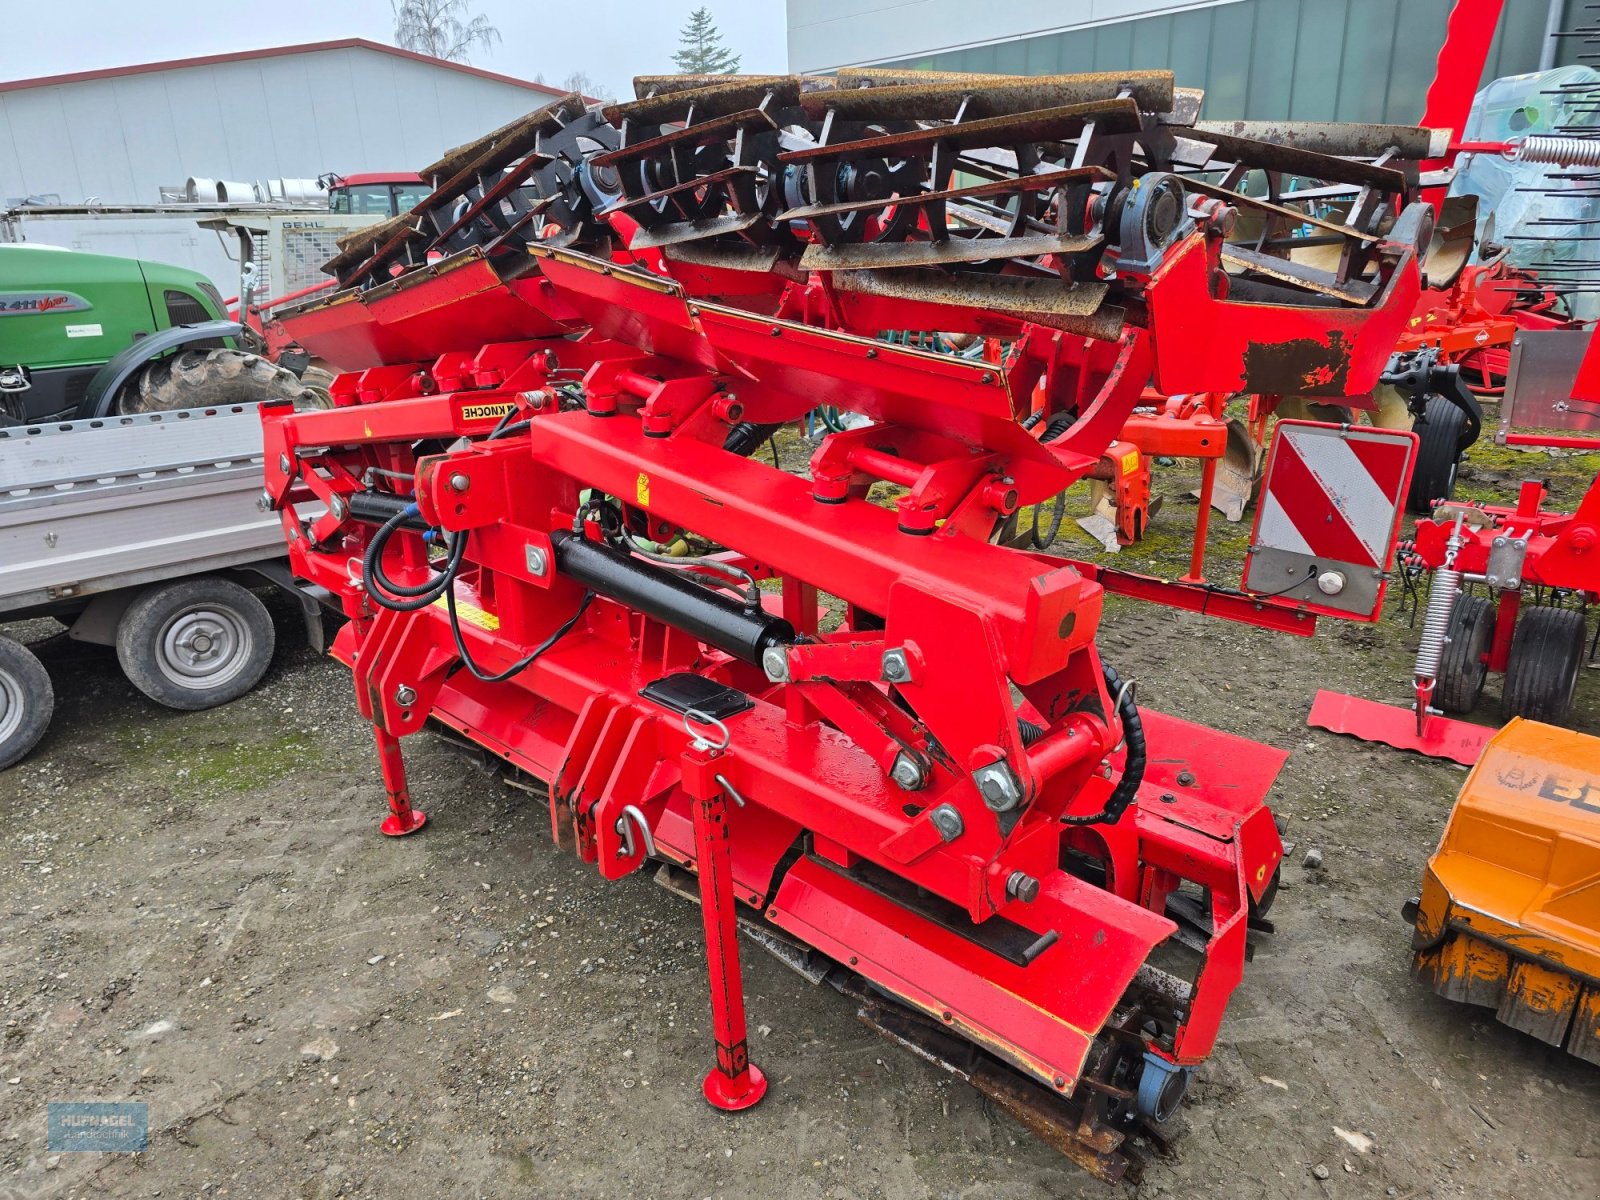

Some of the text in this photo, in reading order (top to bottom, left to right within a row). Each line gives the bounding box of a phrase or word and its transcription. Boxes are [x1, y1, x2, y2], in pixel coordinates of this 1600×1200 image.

[282, 221, 325, 229] GEHL
[9, 299, 37, 311] 411
[463, 405, 506, 418] KNOCHE
